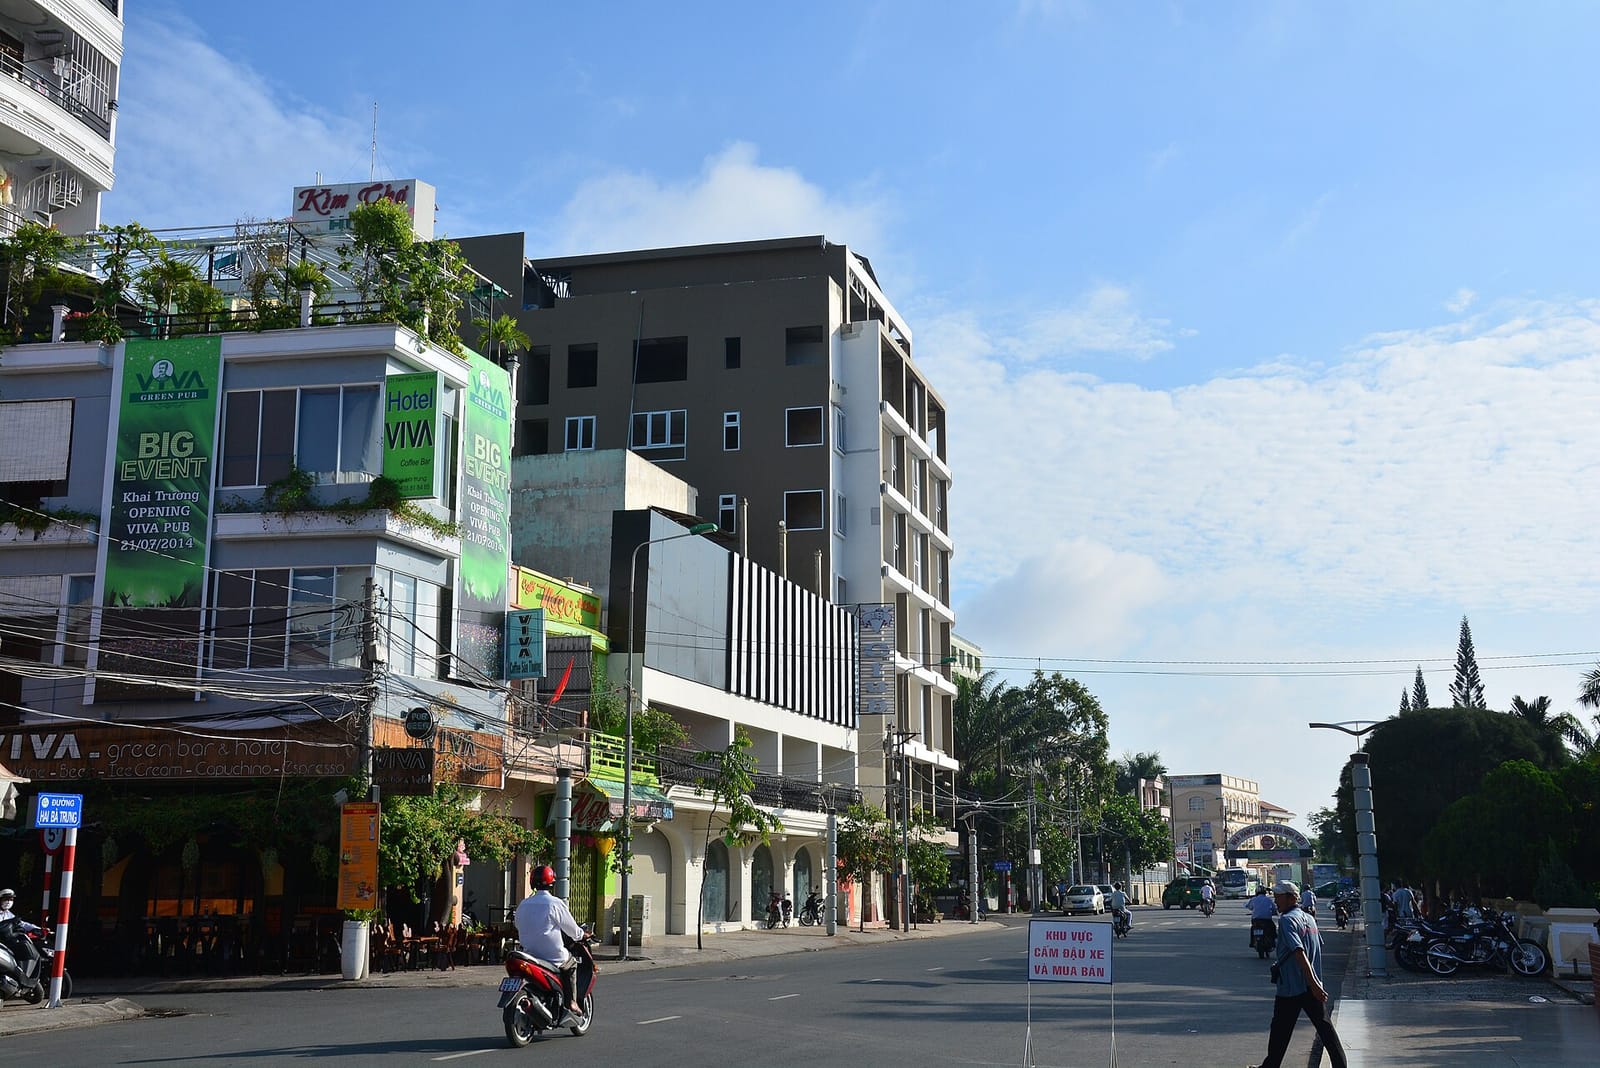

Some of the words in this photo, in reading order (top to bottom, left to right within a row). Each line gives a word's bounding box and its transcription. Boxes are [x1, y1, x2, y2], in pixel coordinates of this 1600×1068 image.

[298, 188, 350, 215] Kim
[136, 370, 204, 391] VIVA
[140, 393, 174, 401] GREEN
[178, 391, 198, 399] PUB
[387, 387, 433, 412] Hotel
[472, 375, 505, 410] VIVA
[138, 431, 194, 459] BIG
[384, 419, 434, 450] VIVA
[474, 433, 502, 468] BIG
[120, 457, 208, 481] EVENT
[465, 454, 508, 490] EVENT
[122, 491, 151, 503] Khai
[467, 484, 483, 500] Khai
[129, 505, 191, 519] OPENING
[470, 502, 501, 523] OPENING
[127, 523, 159, 534] VIVA
[163, 521, 190, 533] PUB
[469, 516, 488, 533] VIVA
[488, 525, 501, 537] PUB
[120, 538, 194, 552] 21/07/2014
[518, 614, 532, 658] VIVA
[107, 743, 172, 764] green
[178, 738, 214, 757] bar
[218, 743, 230, 756] &
[235, 738, 286, 756] hote
[135, 763, 182, 777] Cream
[196, 760, 272, 777] Capuchino
[40, 810, 50, 823] HAI
[51, 807, 59, 823] BÀ
[1046, 931, 1067, 941] KHU
[1071, 930, 1093, 943] VỰC
[1034, 945, 1059, 958] CẤM
[1063, 947, 1086, 960] ĐẬU
[1090, 950, 1105, 960] XE
[1034, 963, 1048, 975] VÀ
[1052, 965, 1077, 976] MUA
[1081, 965, 1105, 977] BÁN
